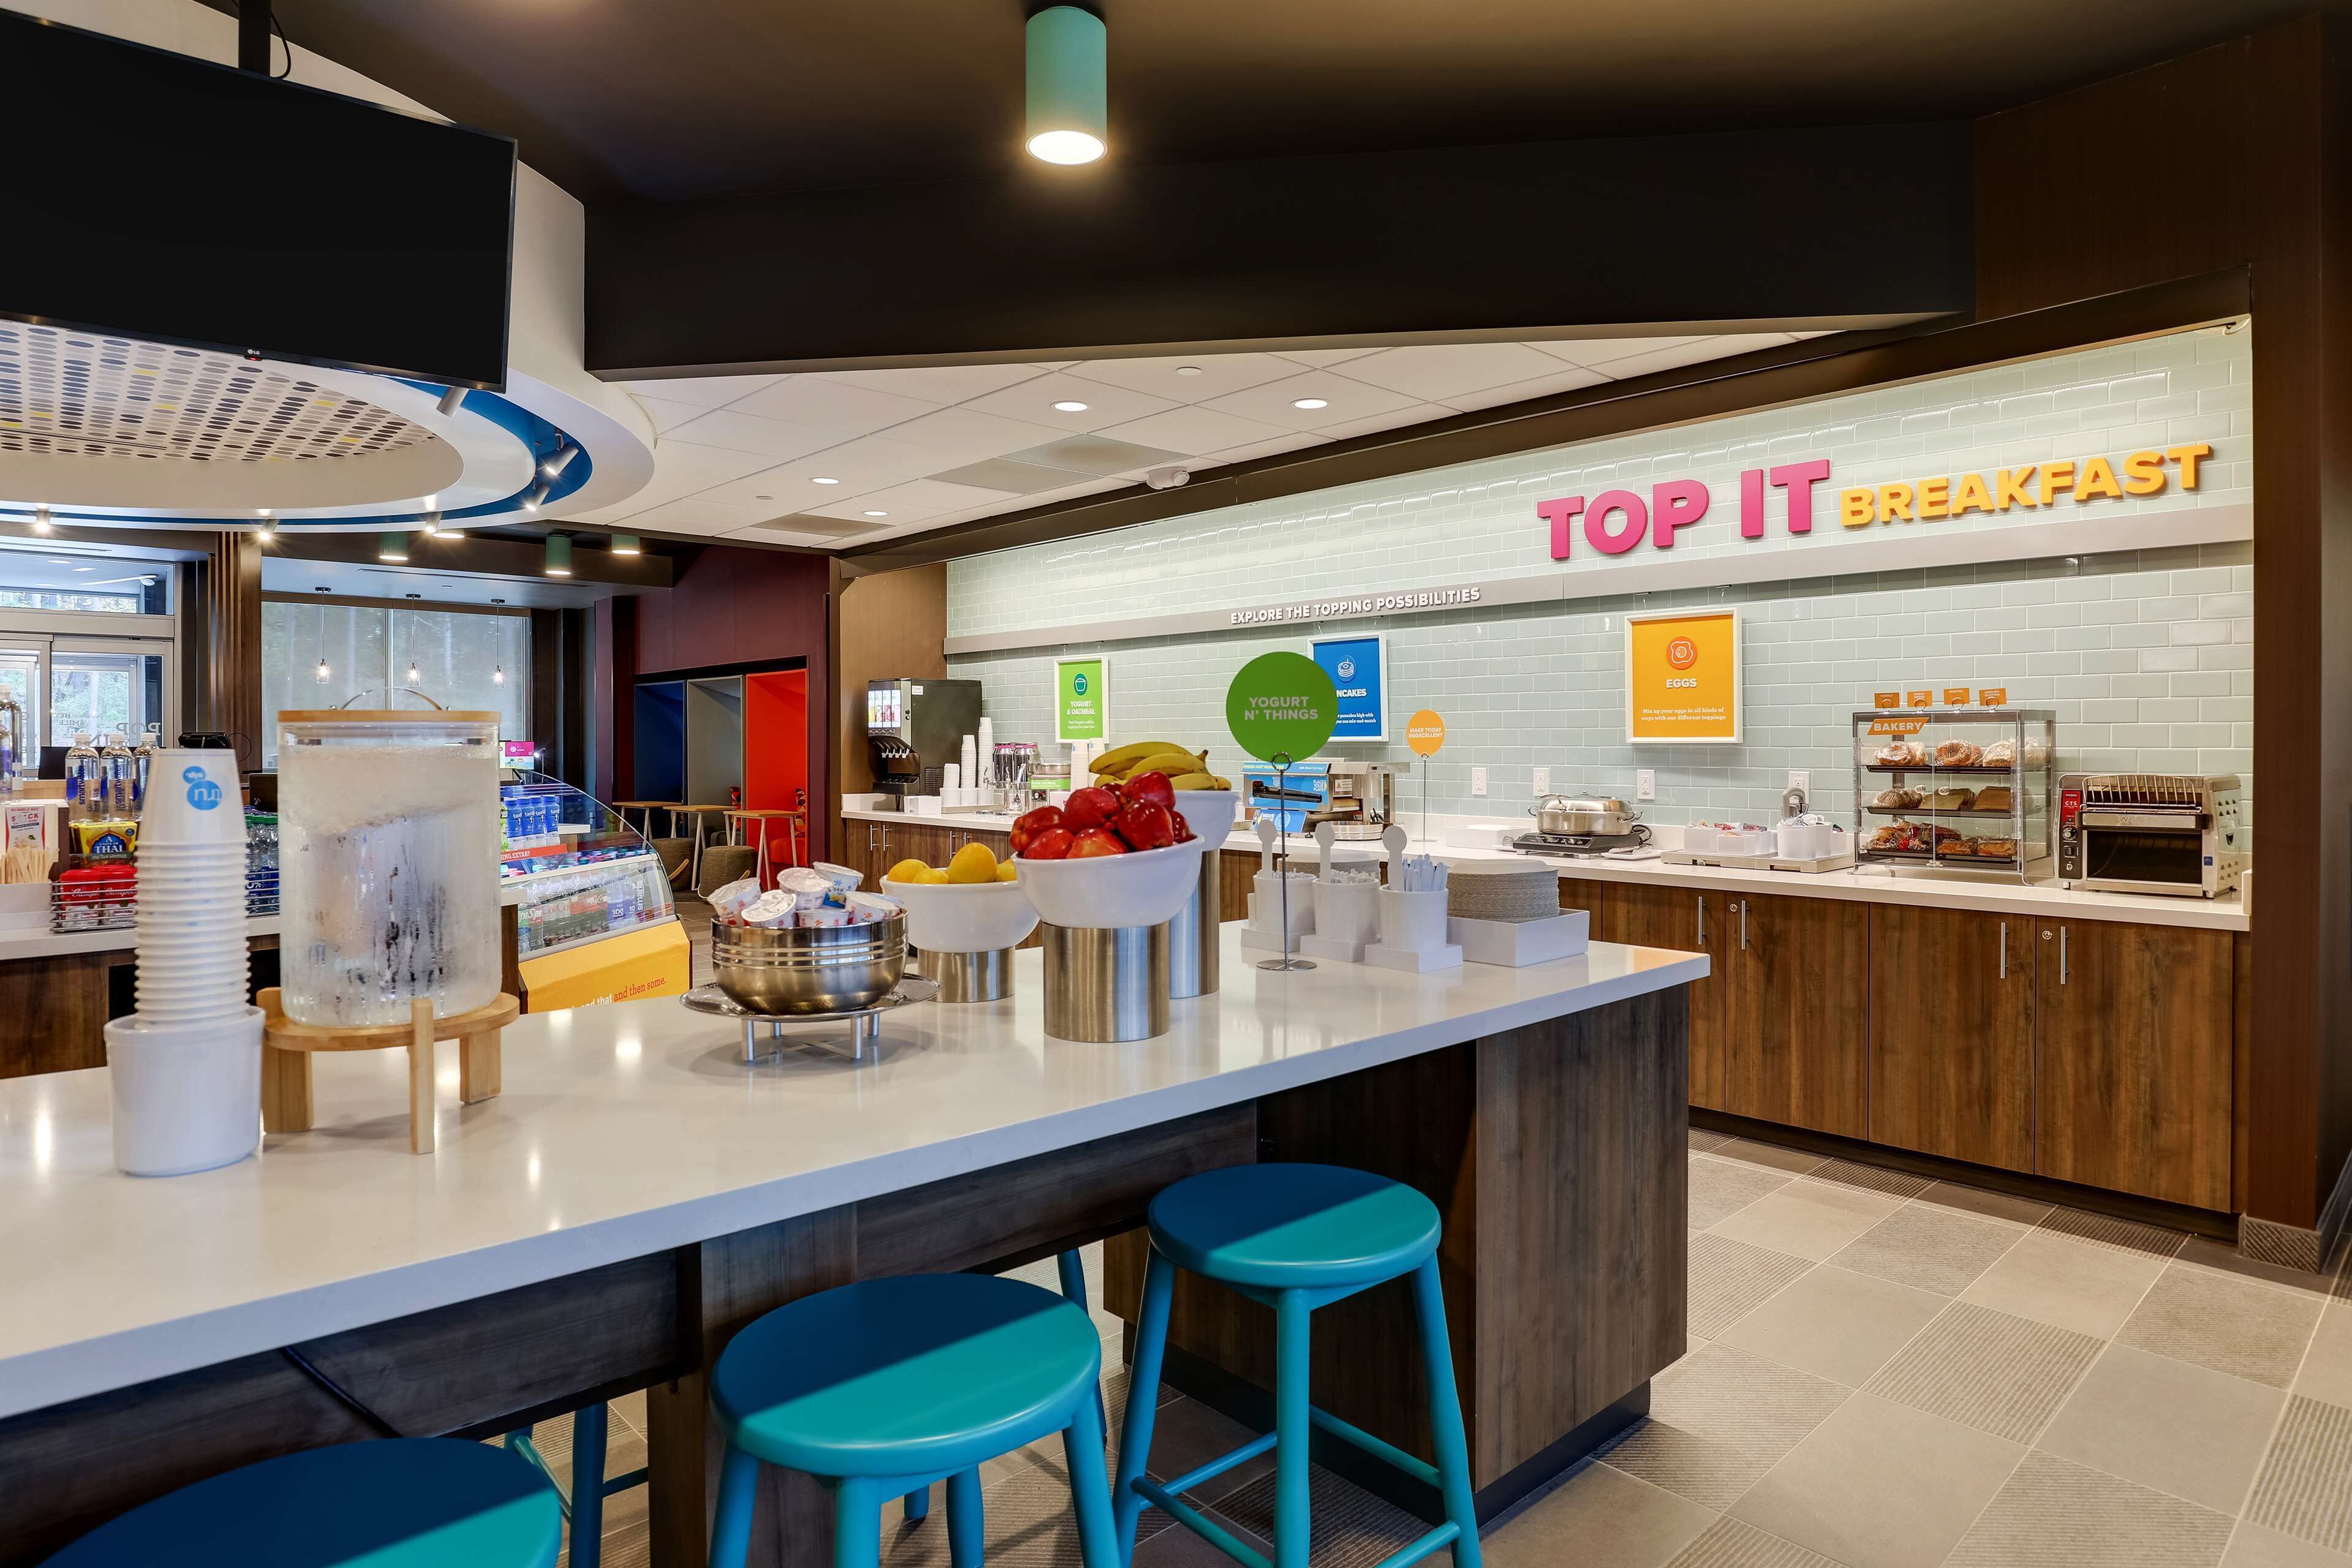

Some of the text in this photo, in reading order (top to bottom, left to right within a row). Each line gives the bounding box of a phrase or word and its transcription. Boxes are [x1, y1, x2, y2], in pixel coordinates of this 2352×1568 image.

[1537, 443, 2209, 559] TOP IT BREAKFAST
[1231, 587, 1480, 624] EXPLORE THE TOPPING POSSIBILITIES
[1666, 678, 1697, 688] EGGS
[1249, 696, 1309, 707] YOGURT
[1264, 709, 1318, 720] THINGS
[1874, 722, 1923, 731] BAKERY
[614, 986, 628, 1002] and
[629, 983, 646, 997] then
[646, 977, 667, 990] some.
